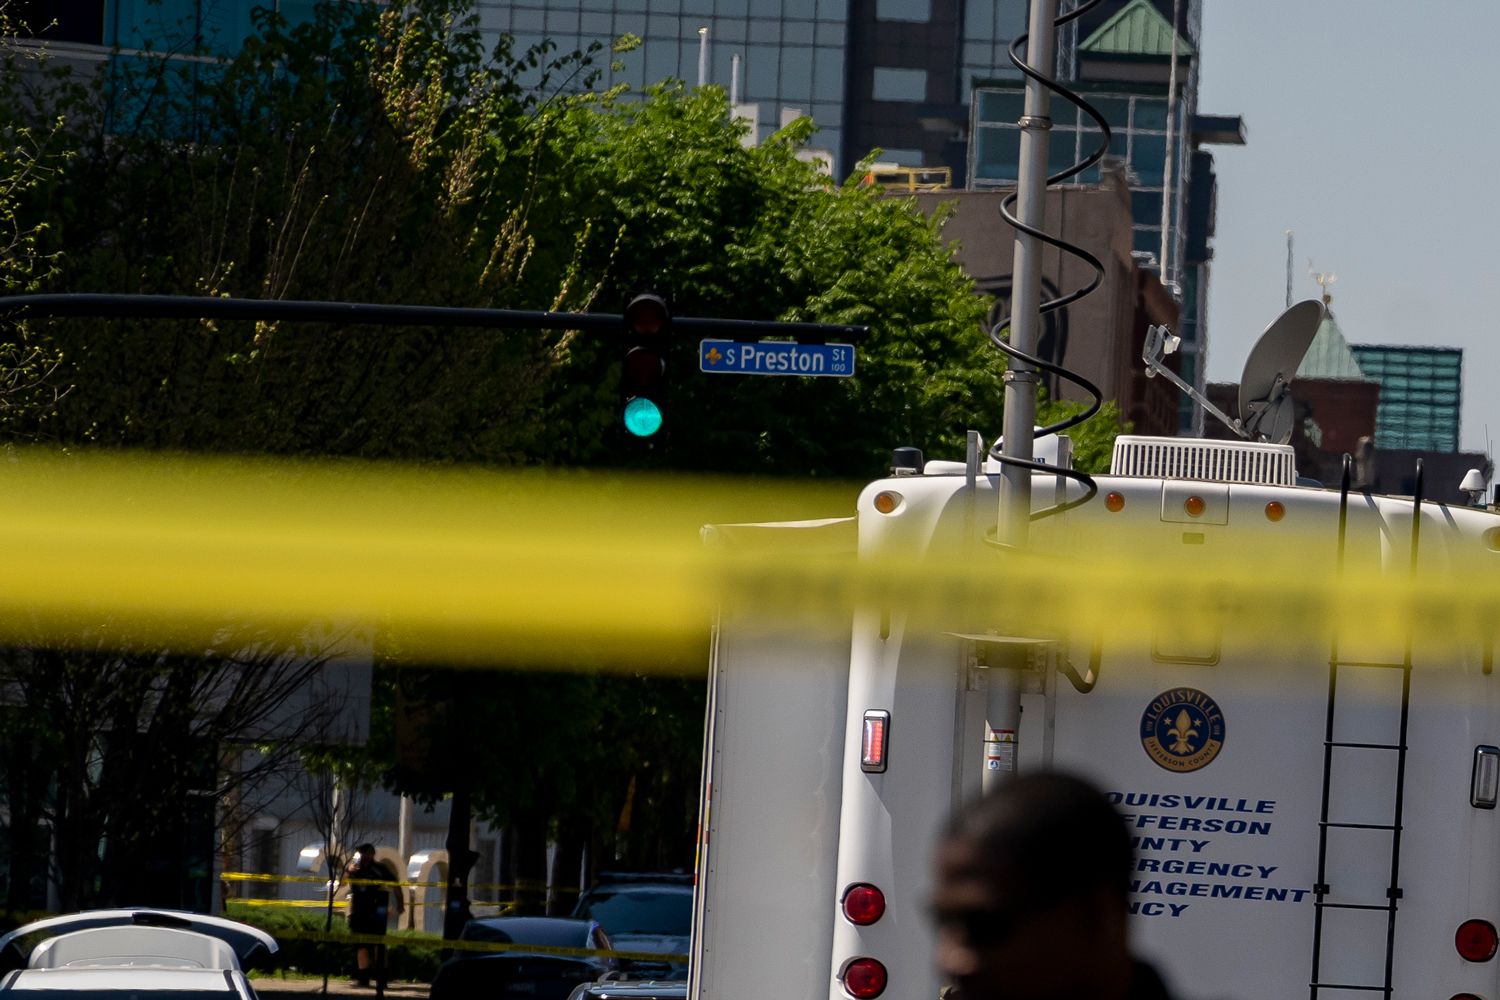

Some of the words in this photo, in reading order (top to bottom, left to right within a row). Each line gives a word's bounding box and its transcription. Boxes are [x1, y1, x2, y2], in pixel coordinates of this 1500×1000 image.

[726, 348, 735, 365] S
[740, 345, 824, 371] Preston
[832, 348, 846, 361] St
[831, 363, 846, 372] 100
[1147, 690, 1222, 722] LOUISVILLE
[1148, 740, 1185, 767] JEFFERSON
[1189, 742, 1217, 766] COUNTY
[1104, 791, 1277, 814] OUISVILLE
[1119, 813, 1272, 835] FFERSON
[1131, 858, 1279, 879] RGENCY
[1129, 880, 1311, 903] NAGEMENT
